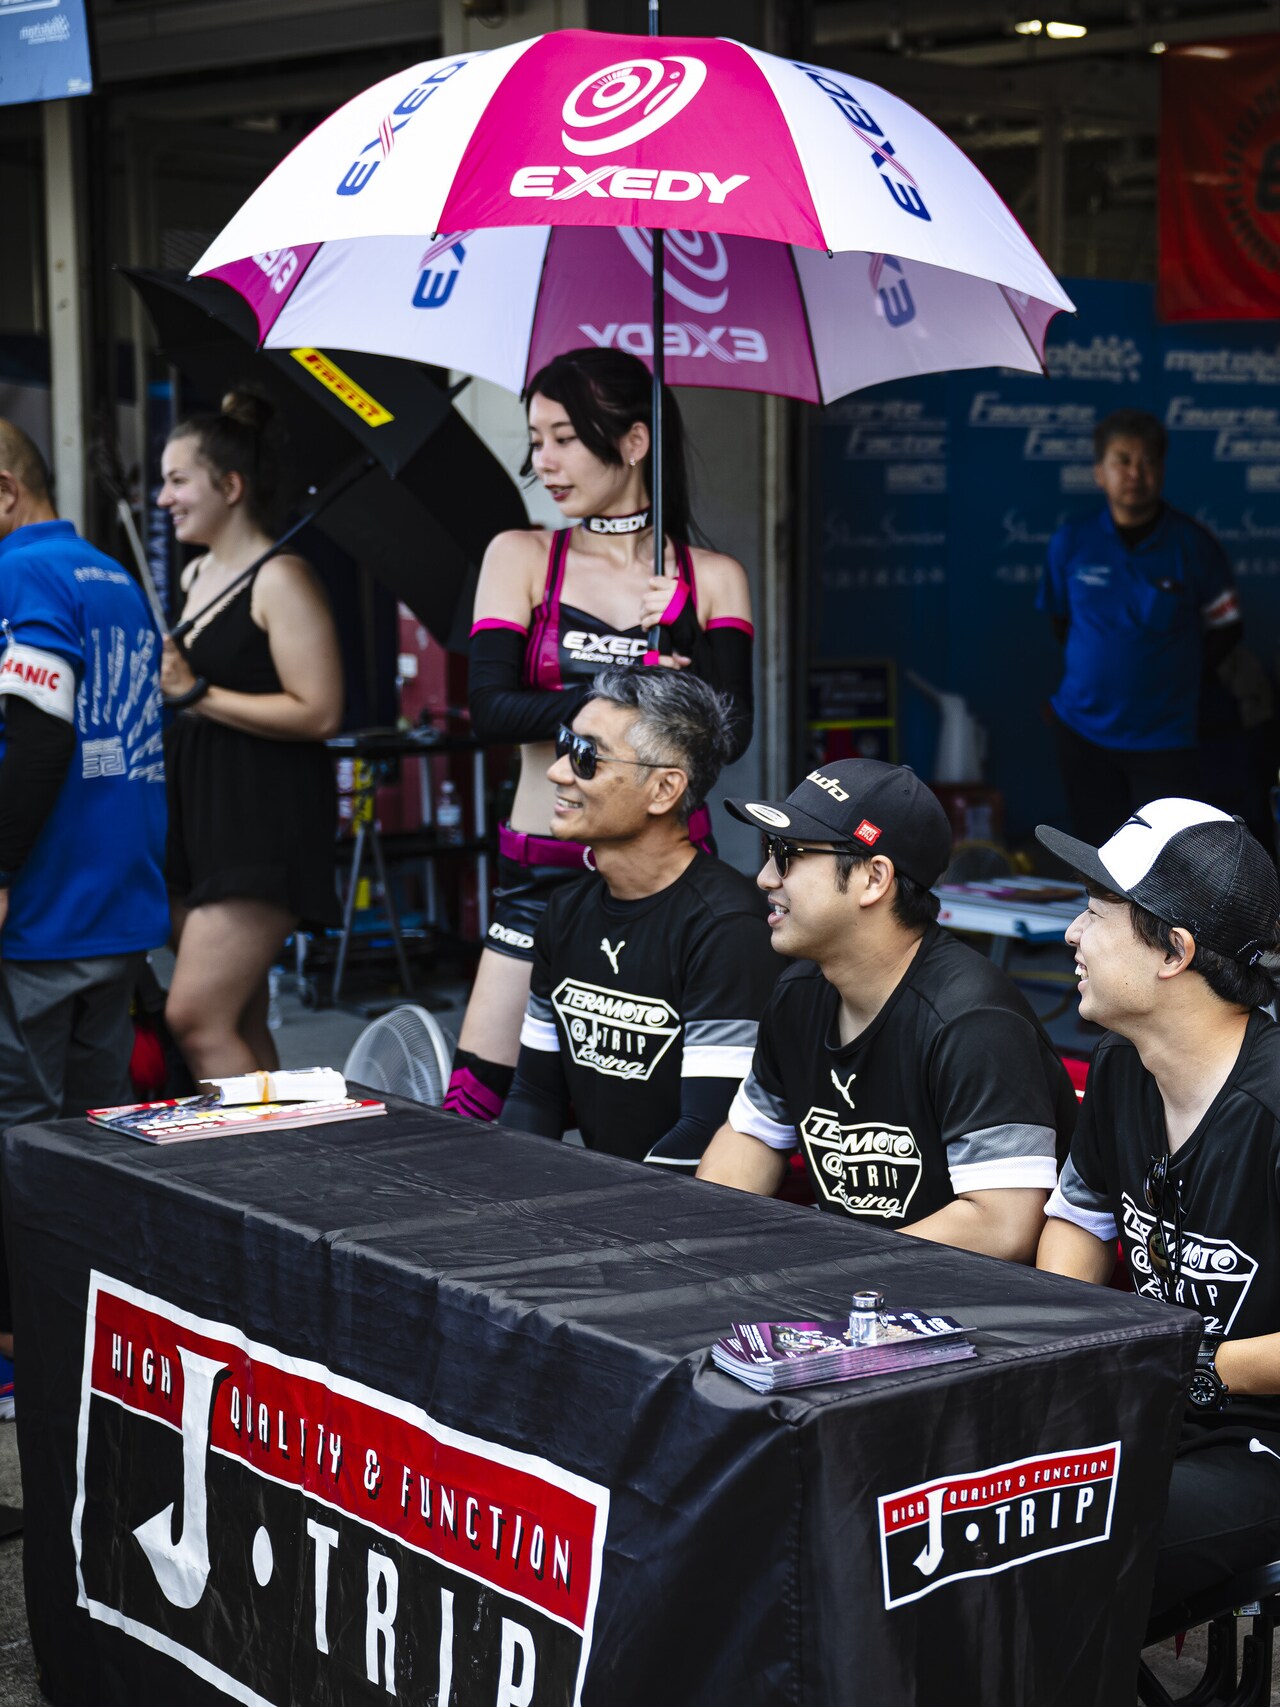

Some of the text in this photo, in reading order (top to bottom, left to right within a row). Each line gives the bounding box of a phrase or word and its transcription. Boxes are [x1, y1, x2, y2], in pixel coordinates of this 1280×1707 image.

[509, 165, 751, 203] EXEDY
[590, 513, 648, 533] EXEDY
[562, 630, 648, 657] EXED
[563, 985, 669, 1027] TERAMOTO
[577, 1044, 647, 1079] Racing
[810, 1115, 914, 1157] TEMOTO
[111, 1332, 571, 1588] HIGH QUALITY & FUNCTION
[891, 1459, 1108, 1524] HIGH QUALITY & FUNCTION
